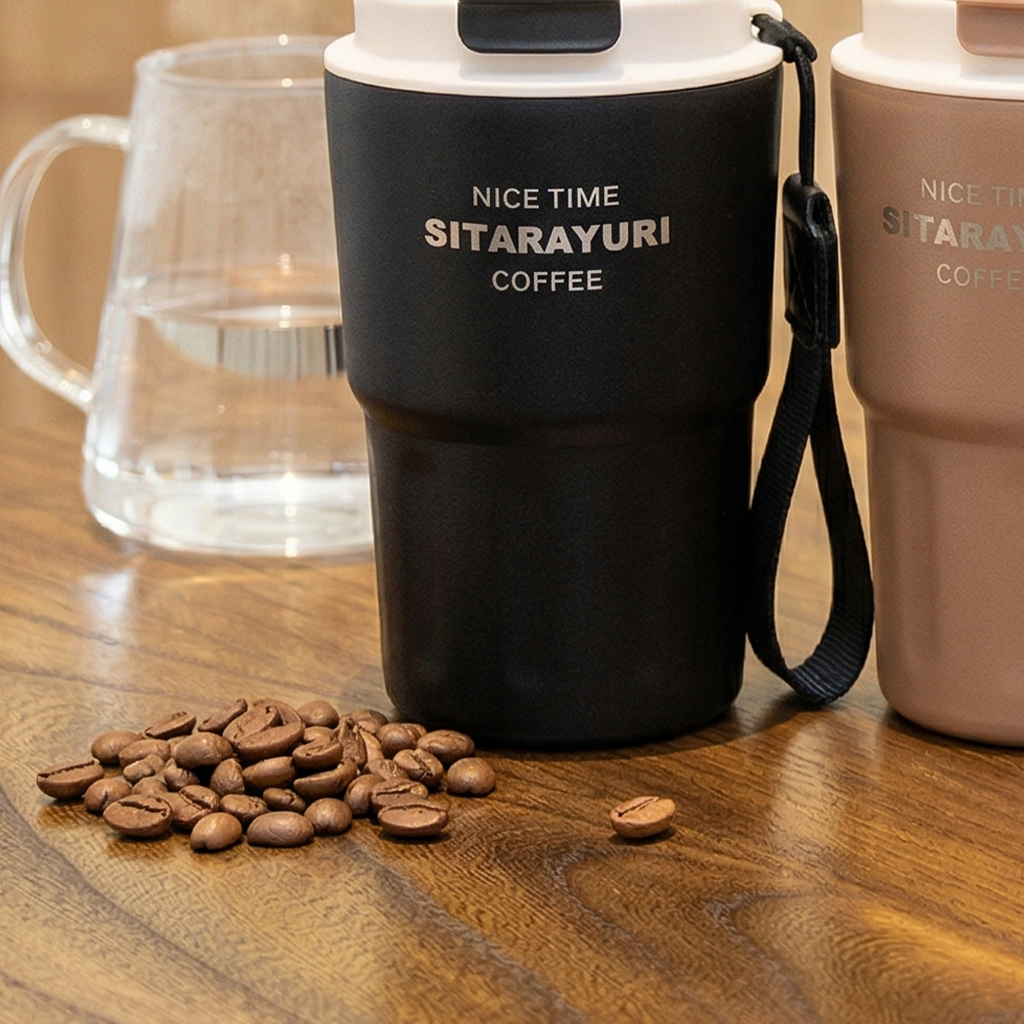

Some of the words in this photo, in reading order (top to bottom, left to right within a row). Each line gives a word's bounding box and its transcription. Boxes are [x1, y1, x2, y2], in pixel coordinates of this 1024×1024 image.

[472, 186, 539, 209] NICE
[548, 185, 620, 208] TIME
[921, 178, 982, 205] NICE
[424, 216, 670, 254] SITARAYURI
[492, 269, 603, 292] COFFEE
